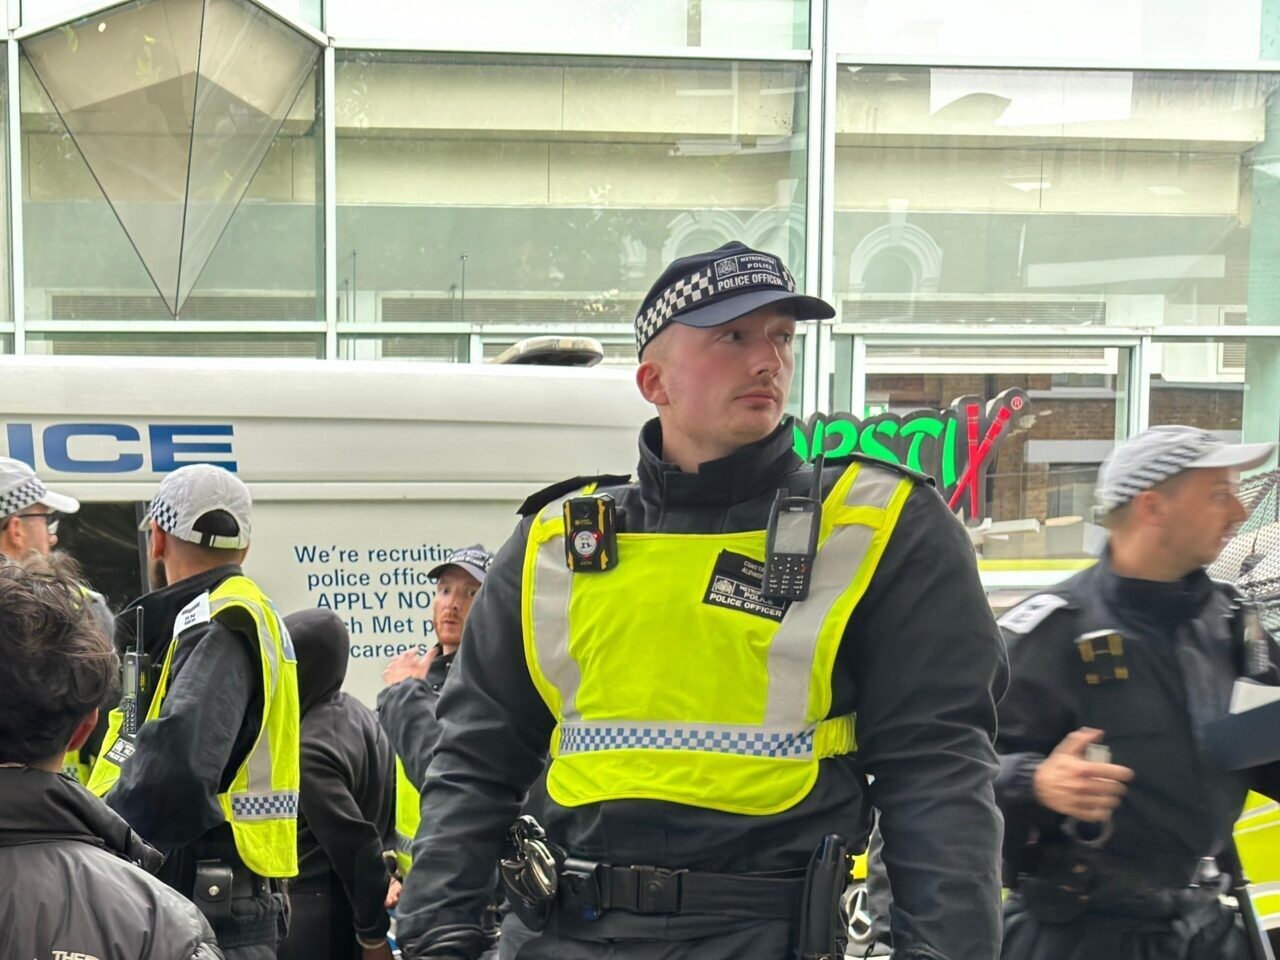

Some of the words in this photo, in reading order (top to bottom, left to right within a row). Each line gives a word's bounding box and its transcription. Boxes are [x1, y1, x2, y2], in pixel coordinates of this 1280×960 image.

[718, 275, 750, 291] POLICE
[752, 273, 783, 286] OFFICER
[294, 545, 359, 563] We're
[368, 544, 453, 563] recruitin
[307, 569, 370, 591] police
[317, 592, 389, 610] APPLY
[398, 591, 436, 609] NO
[709, 592, 742, 607] POLICE
[744, 601, 783, 617] OFFICER
[373, 616, 414, 634] Met
